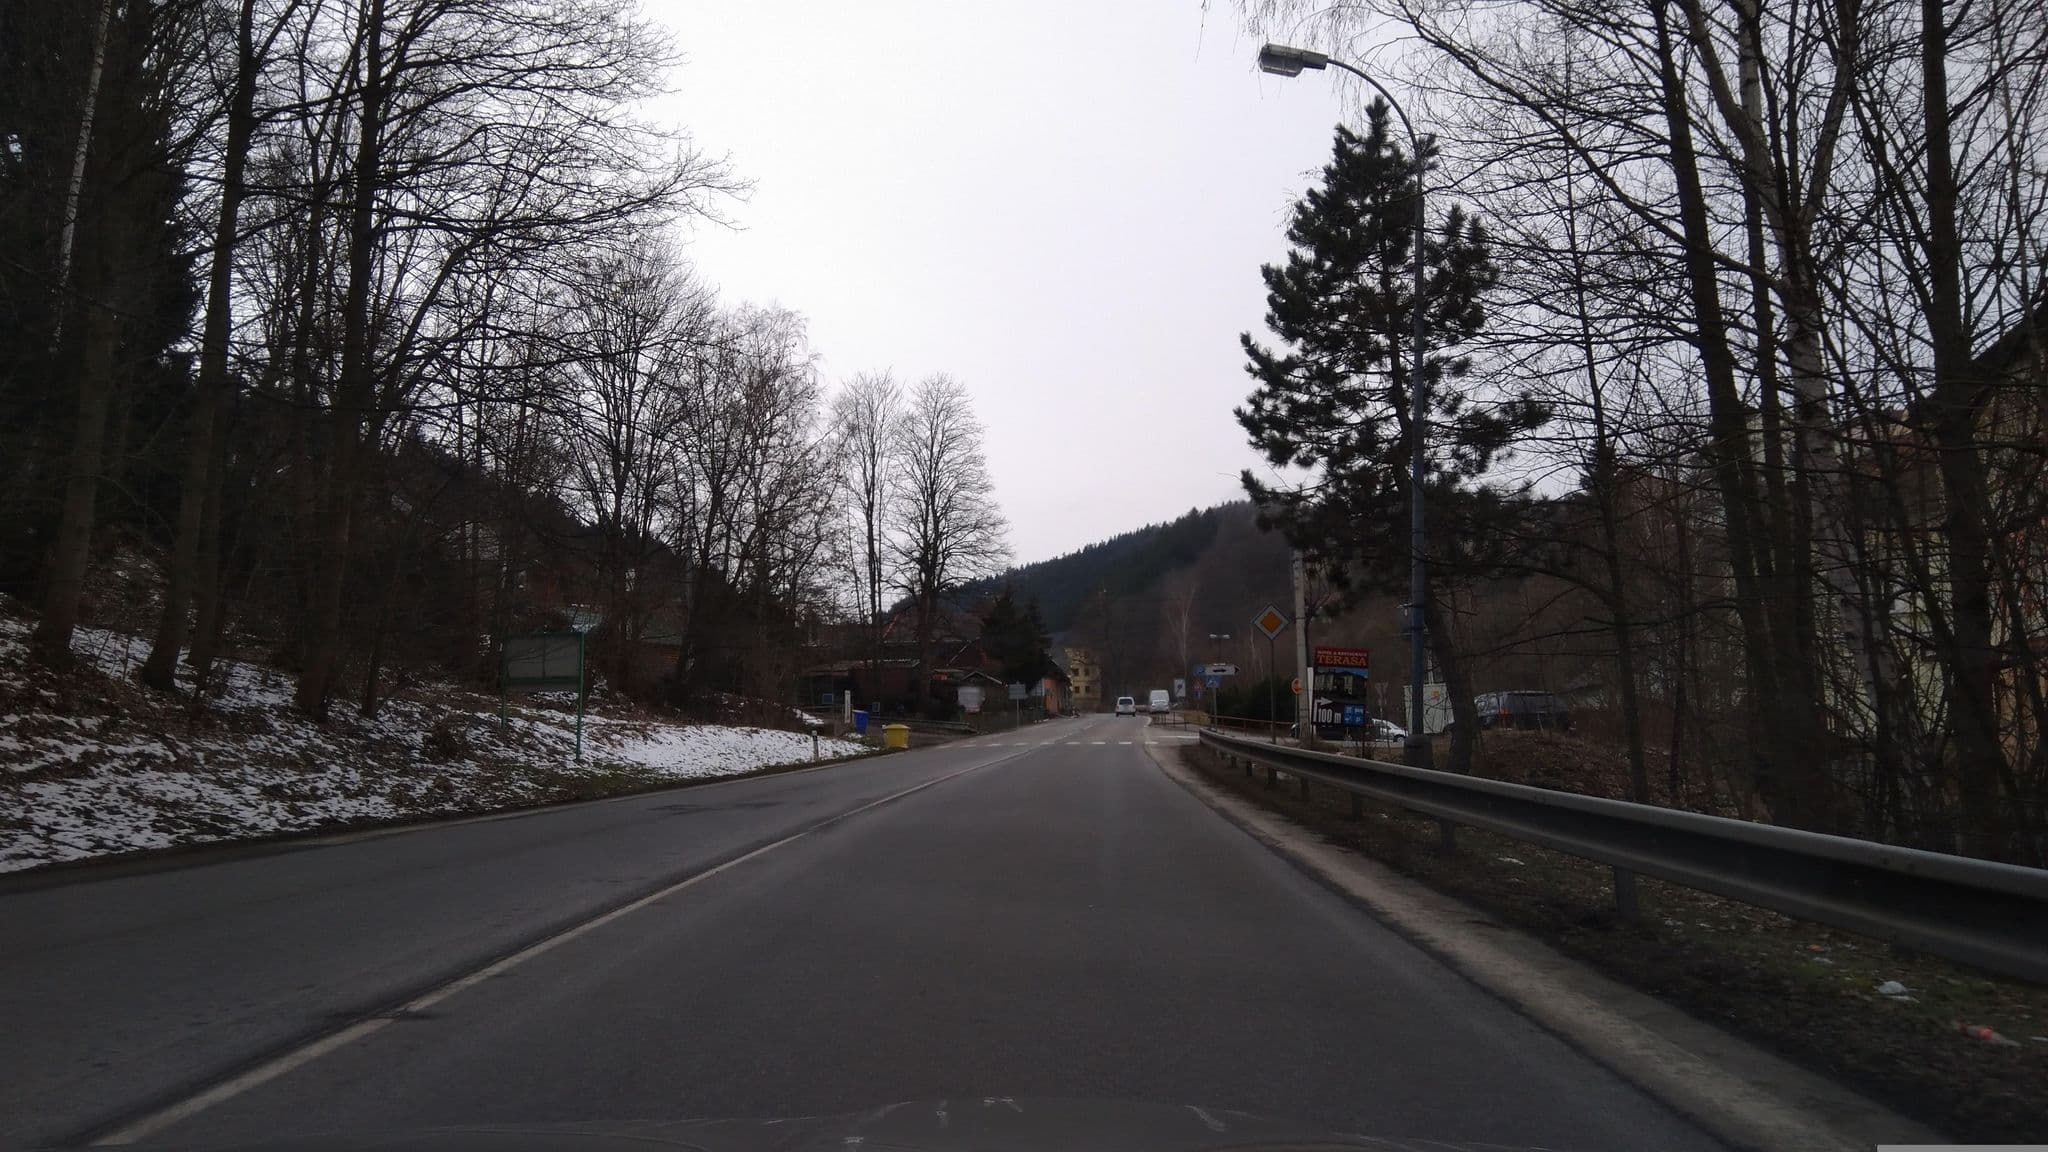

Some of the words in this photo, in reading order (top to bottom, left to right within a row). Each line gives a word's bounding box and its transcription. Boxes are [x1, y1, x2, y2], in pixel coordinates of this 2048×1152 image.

[1318, 655, 1367, 666] TERASA
[1318, 708, 1333, 723] 100
[1334, 712, 1342, 724] m
